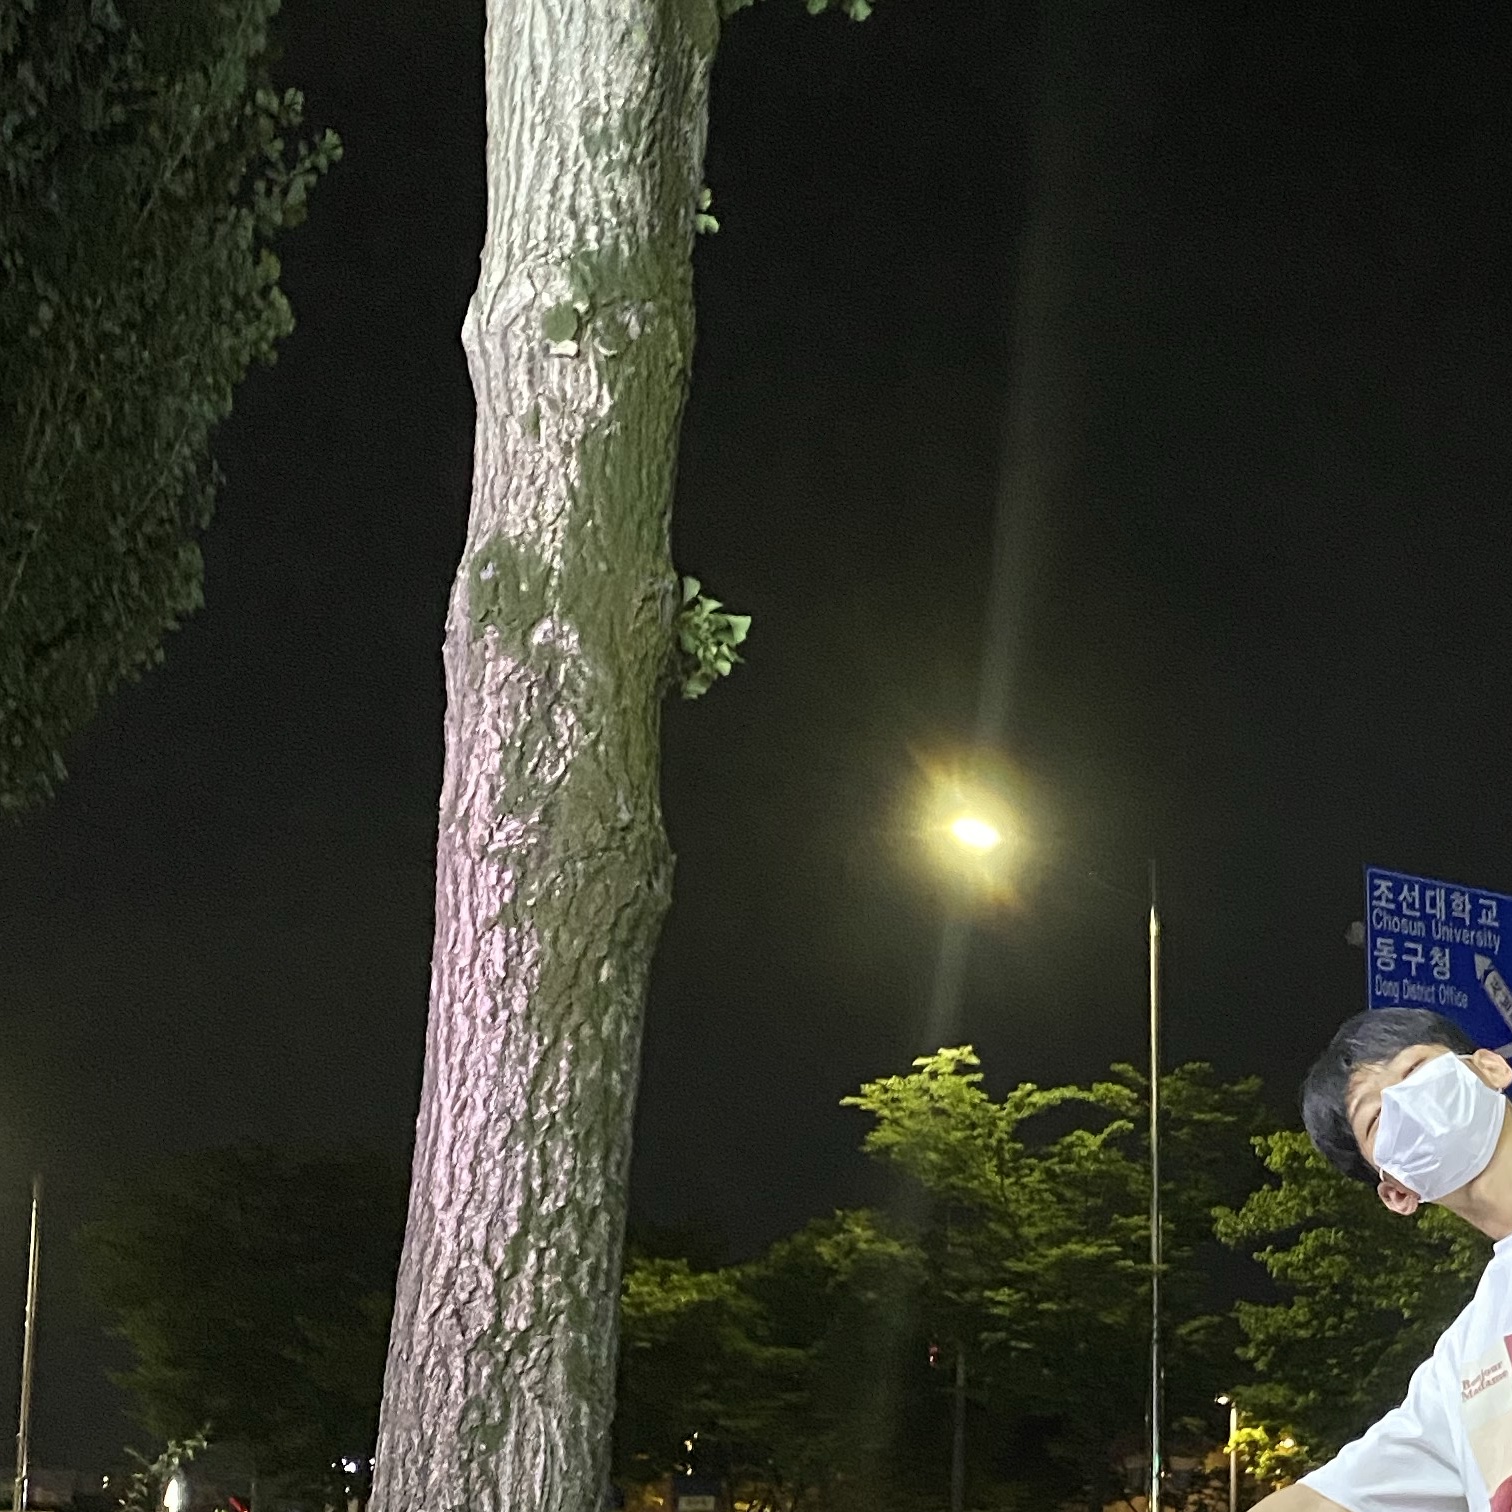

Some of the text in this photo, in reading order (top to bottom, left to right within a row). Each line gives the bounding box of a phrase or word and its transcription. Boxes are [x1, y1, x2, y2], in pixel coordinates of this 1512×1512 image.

[1371, 879, 1500, 927] 조선대학교
[1372, 908, 1501, 955] Chosun University
[1373, 937, 1451, 980] 동구청
[1375, 973, 1400, 1003] Dong
[1402, 978, 1436, 1004] District
[1438, 984, 1469, 1008] Office
